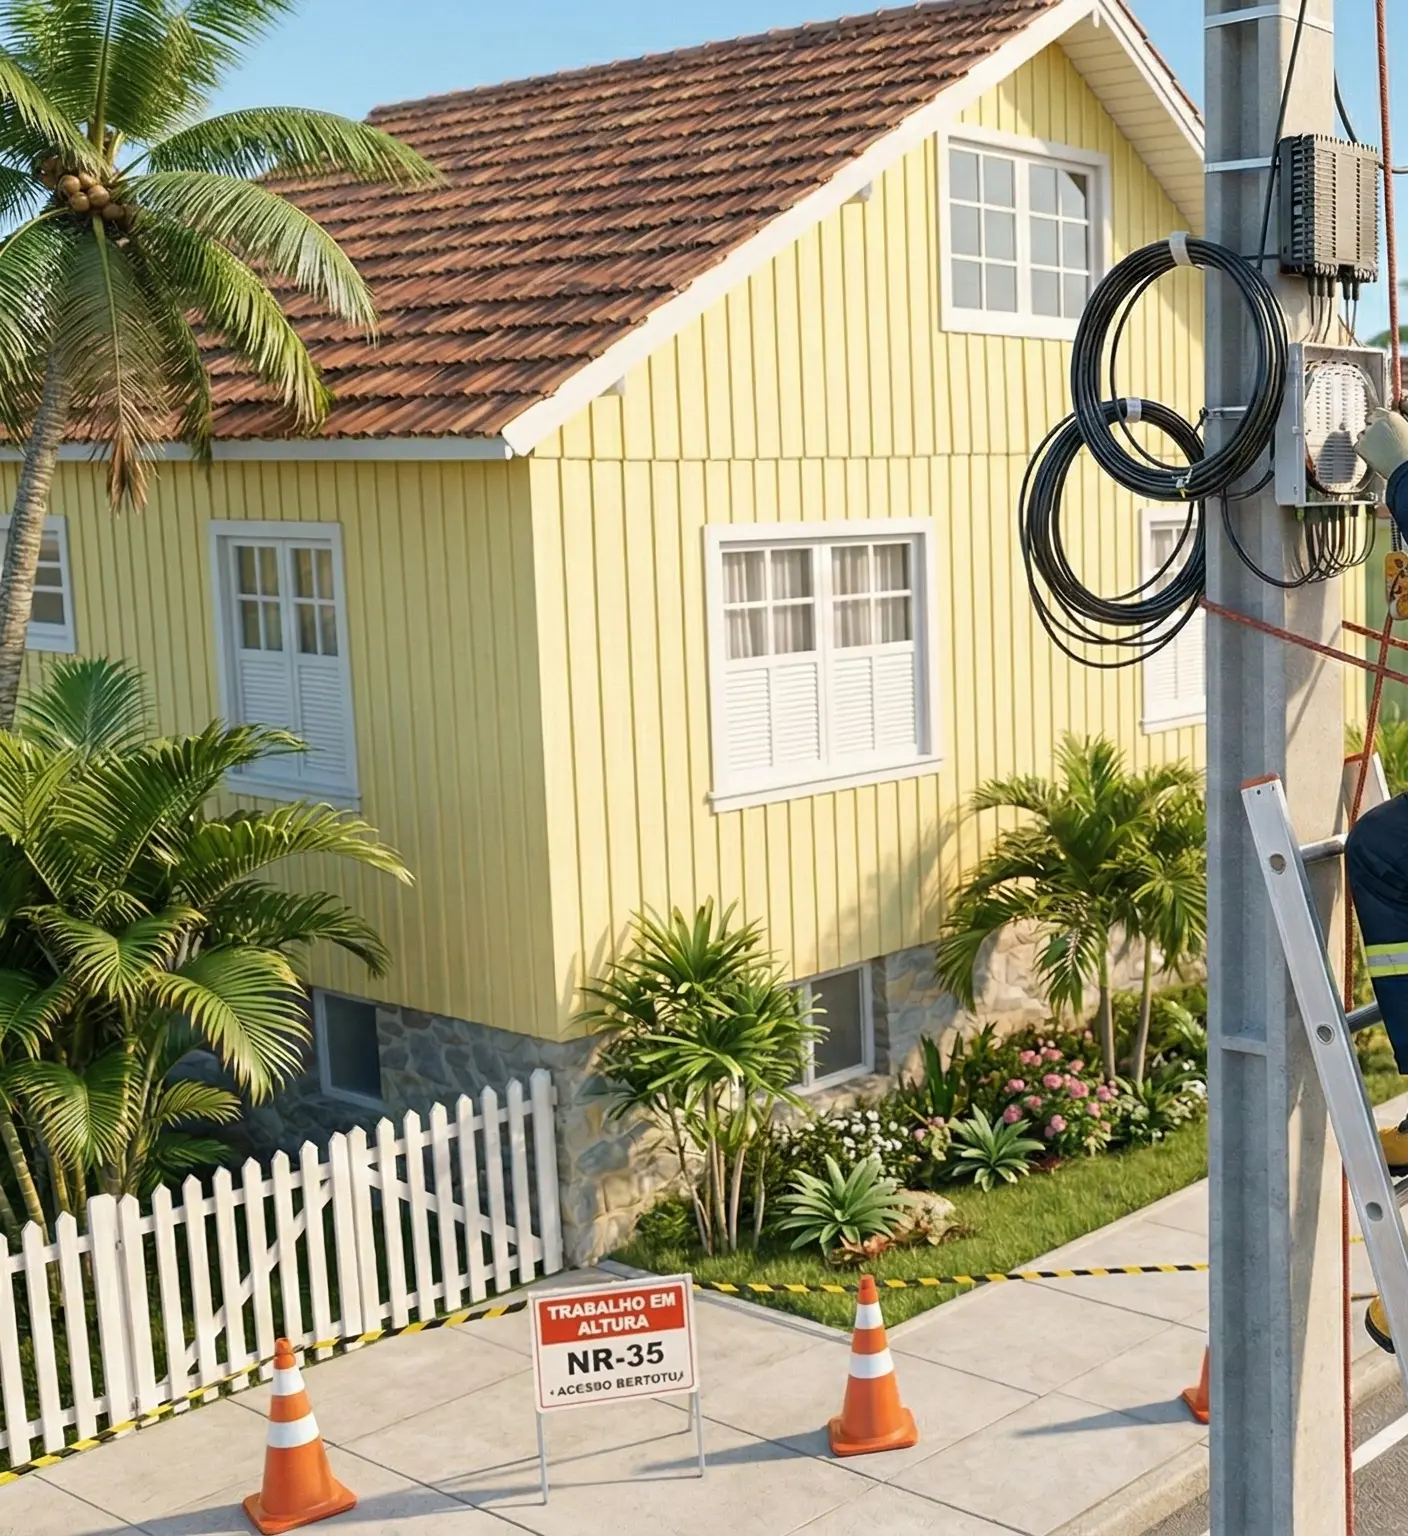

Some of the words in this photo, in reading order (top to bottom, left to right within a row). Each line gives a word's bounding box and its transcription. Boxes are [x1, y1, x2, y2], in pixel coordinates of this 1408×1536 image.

[547, 1296, 646, 1321] TRABALHO
[650, 1292, 676, 1309] EM
[577, 1314, 649, 1336] ALTURA
[567, 1341, 665, 1376] NR-35
